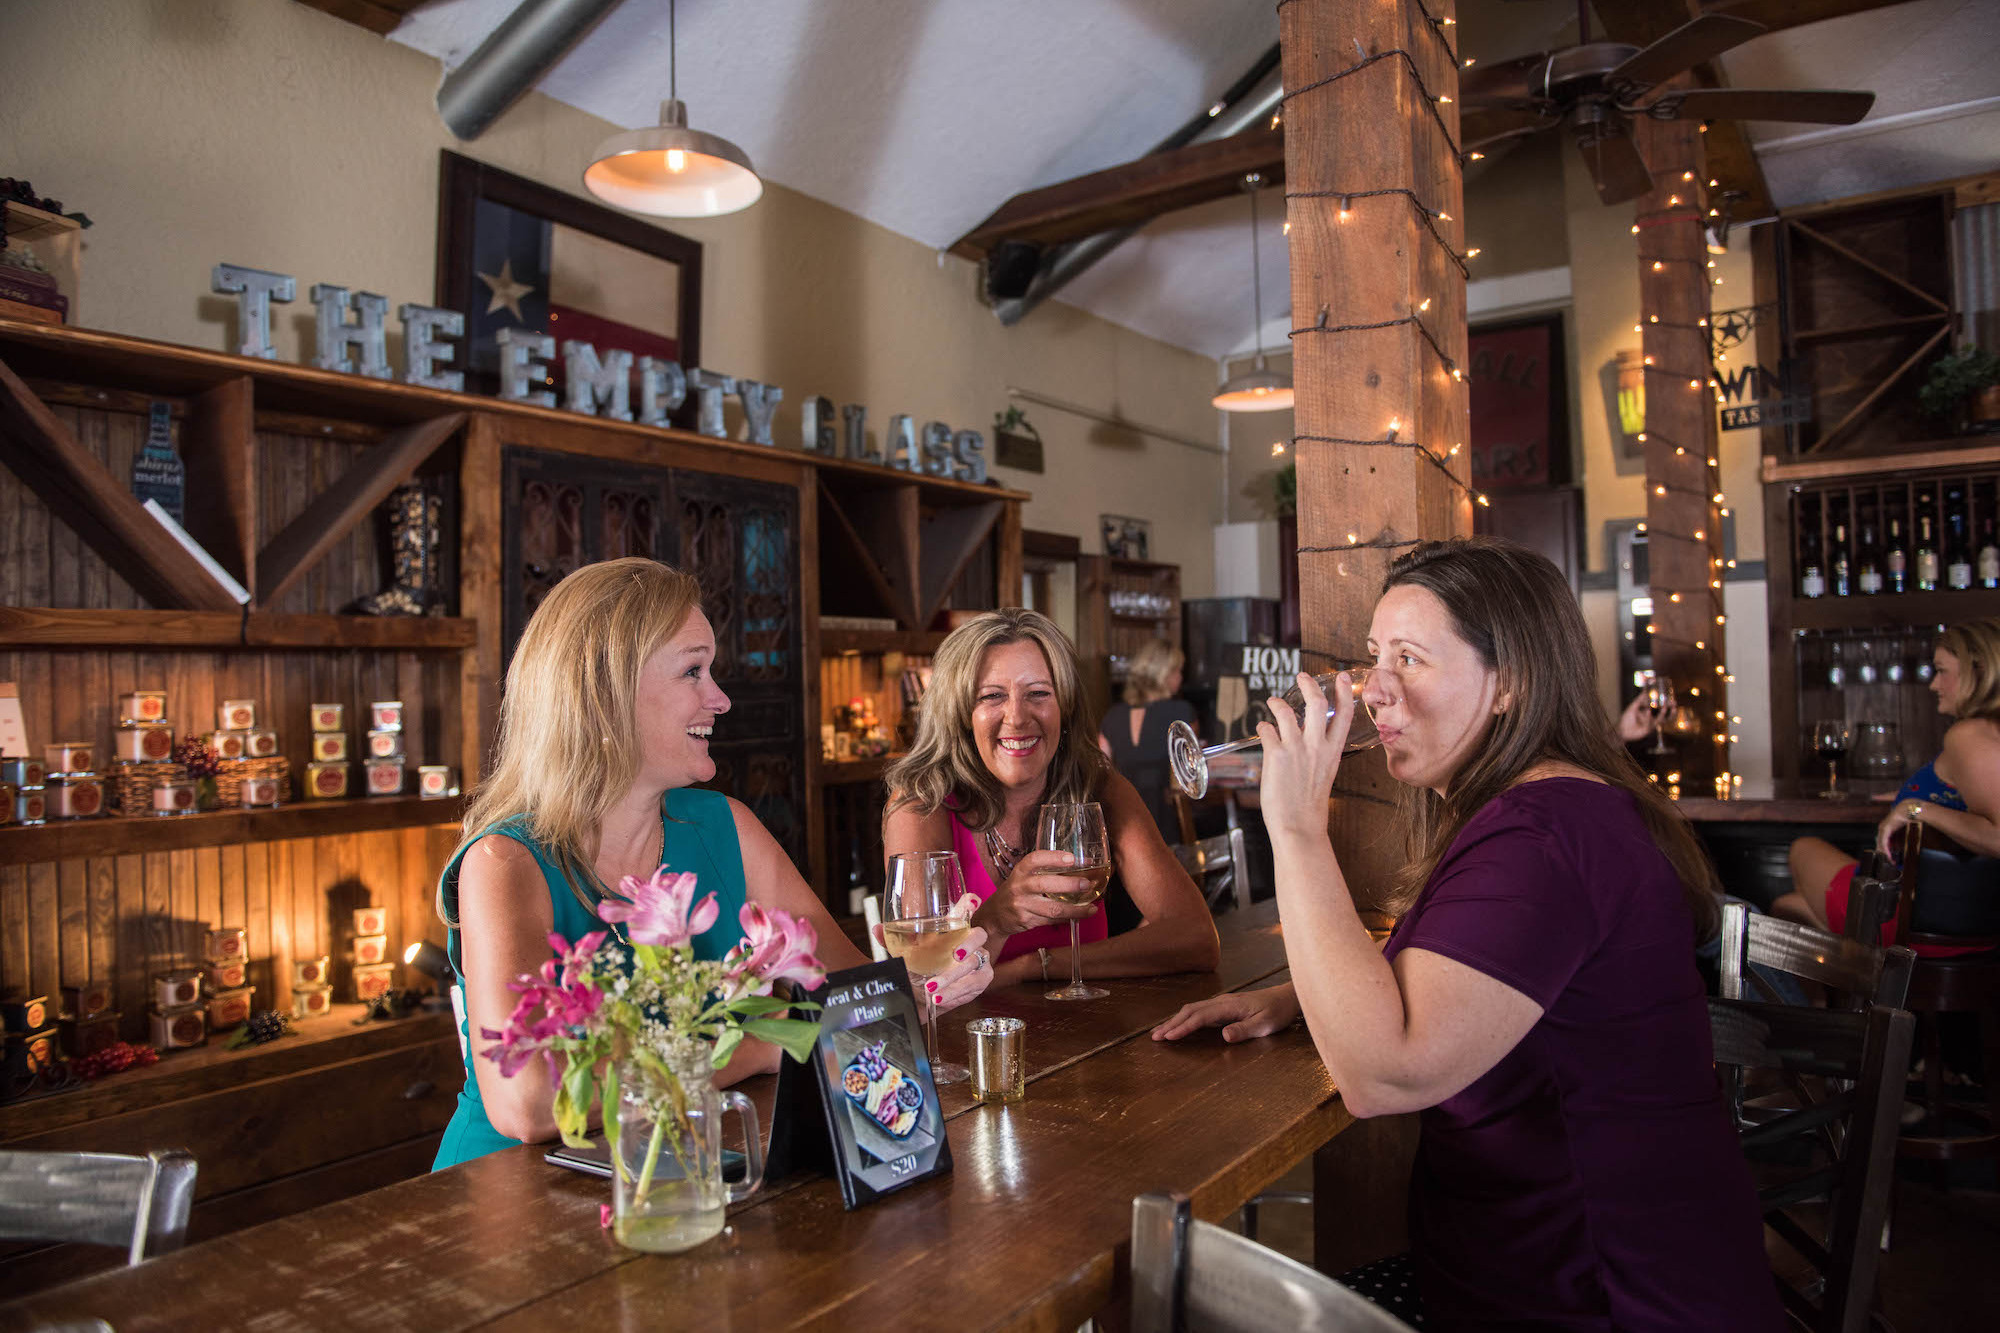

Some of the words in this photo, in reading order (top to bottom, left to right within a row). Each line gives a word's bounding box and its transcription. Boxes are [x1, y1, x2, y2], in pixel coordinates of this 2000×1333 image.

[211, 263, 466, 393] THE
[496, 327, 784, 446] EMPTY
[801, 394, 988, 485] GLASS
[1242, 647, 1301, 674] HOM
[853, 985, 864, 1001] &
[853, 1004, 886, 1022] Plate
